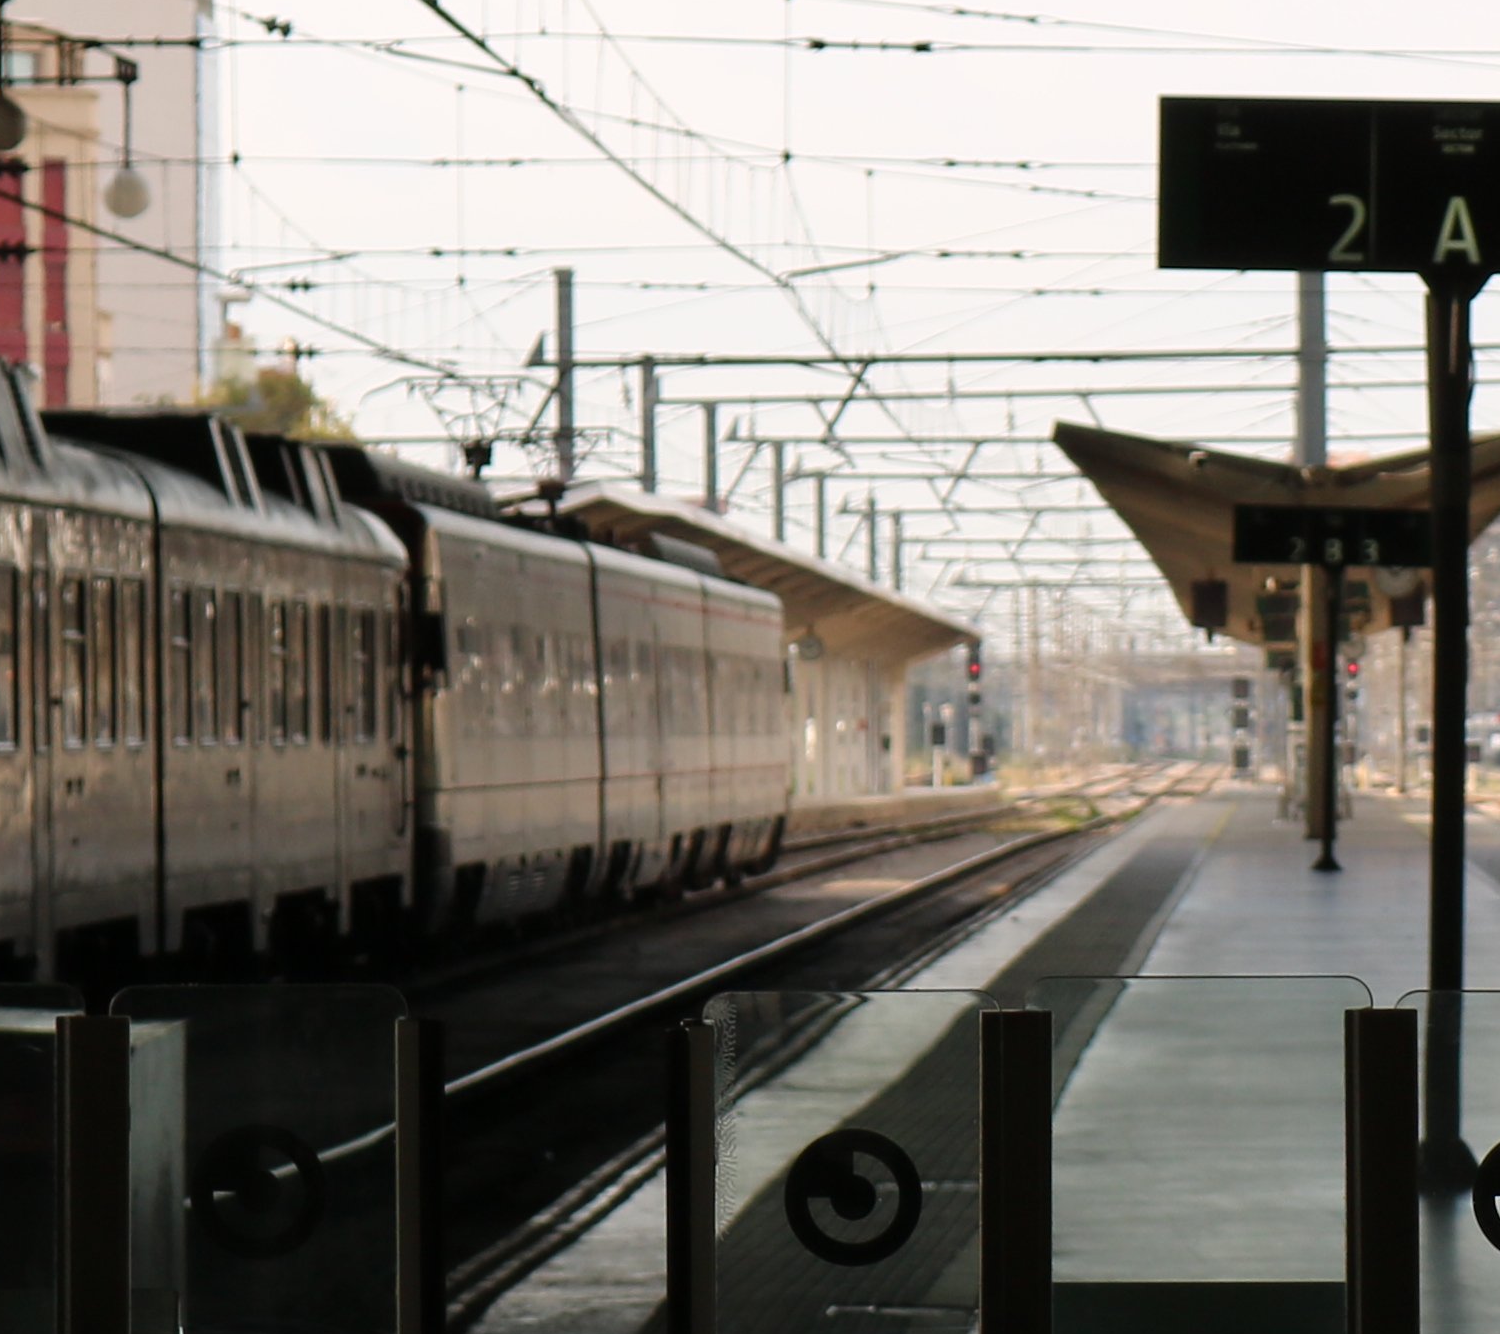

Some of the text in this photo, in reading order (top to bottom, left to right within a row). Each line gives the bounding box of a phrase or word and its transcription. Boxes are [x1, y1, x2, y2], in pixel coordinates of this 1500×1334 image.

[1326, 192, 1368, 263] 2
[1431, 195, 1482, 265] A
[1288, 535, 1306, 562] 2
[1362, 537, 1380, 564] 3
